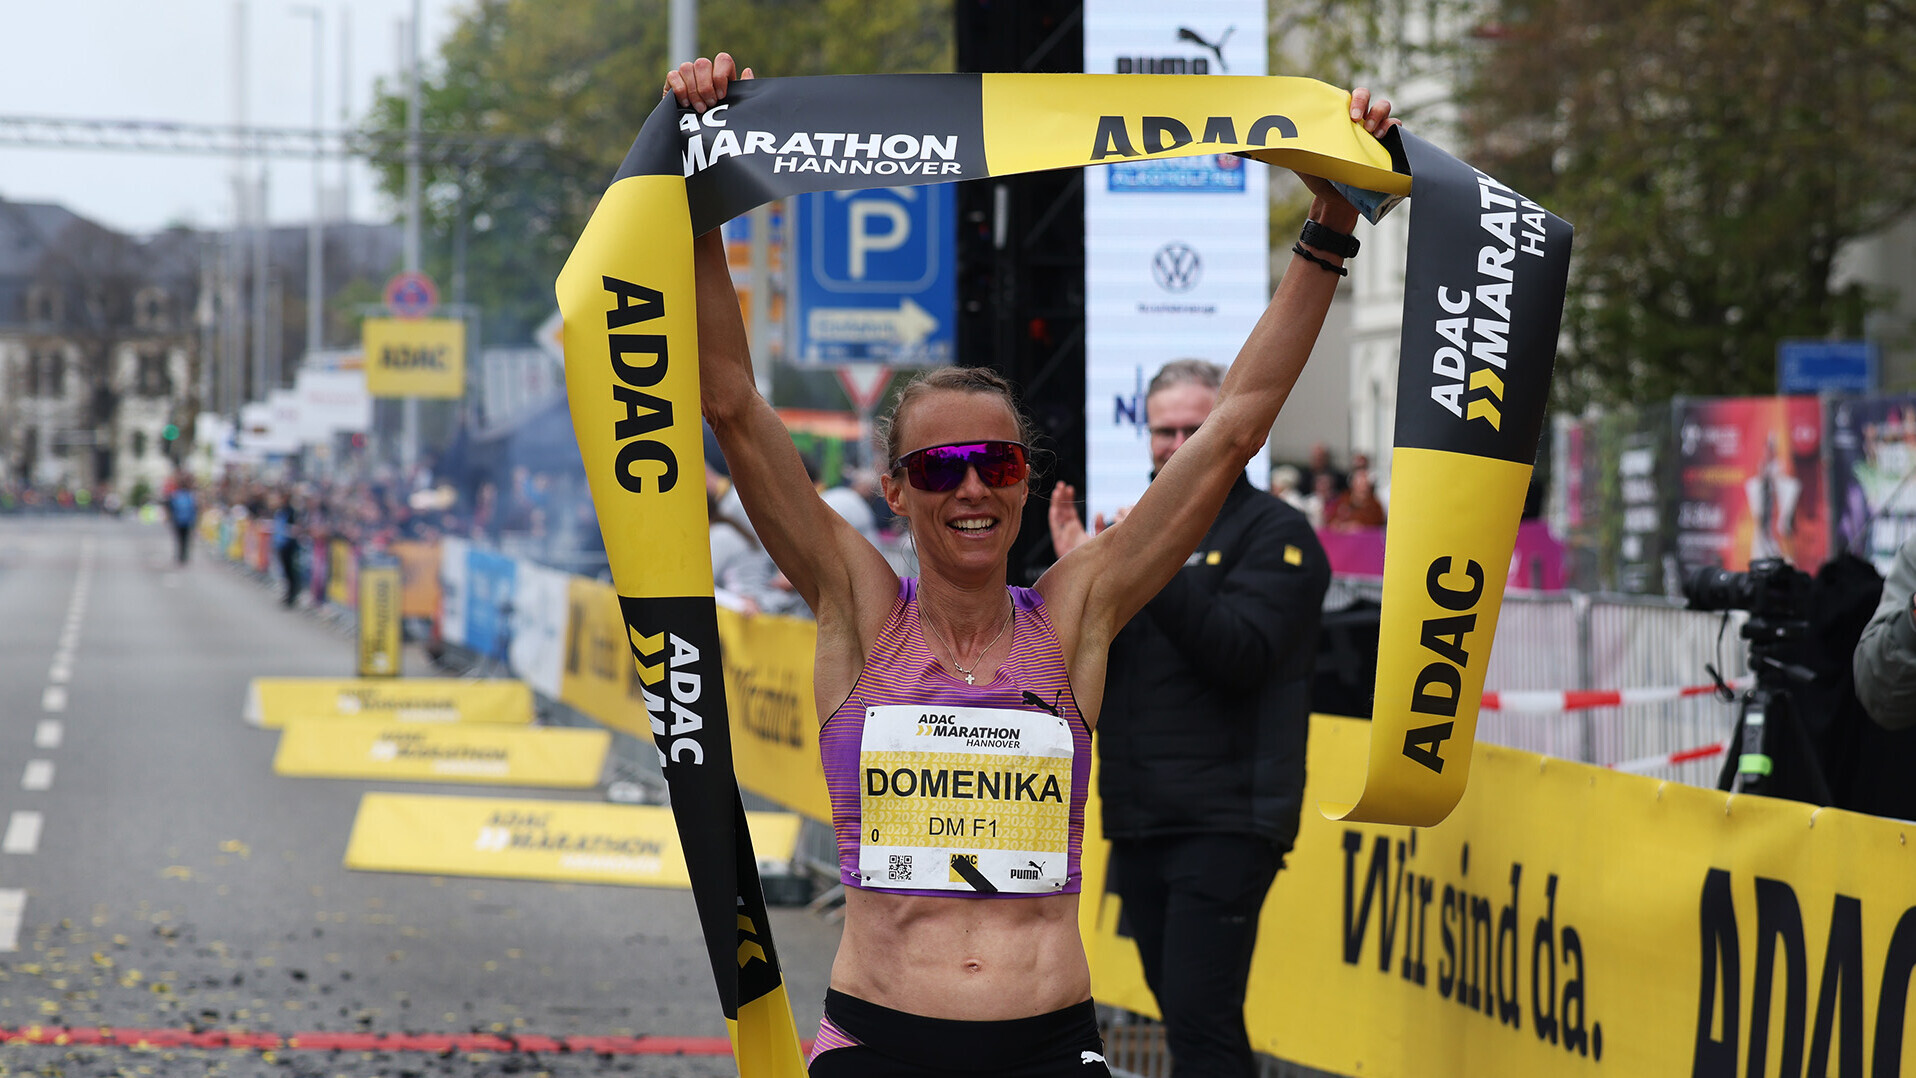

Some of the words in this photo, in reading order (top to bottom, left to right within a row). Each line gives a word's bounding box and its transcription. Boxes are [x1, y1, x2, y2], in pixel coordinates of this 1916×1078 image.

[773, 157, 962, 175] HANNOVER
[1431, 285, 1471, 418] ADAC
[602, 275, 679, 494] ADAC
[1402, 556, 1484, 774] ADAC
[669, 632, 704, 765] ADAC
[918, 713, 956, 725] ADAC
[933, 725, 1021, 740] MARATHON
[966, 739, 1021, 749] HANNOVER
[866, 768, 1063, 803] DOMENIKA
[871, 828, 880, 843] 0
[929, 817, 965, 837] DM
[973, 818, 997, 838] F1
[1010, 868, 1039, 880] PUMA
[1342, 827, 1433, 988] Wir
[1438, 842, 1522, 1031] sind
[1531, 872, 1603, 1063] da.
